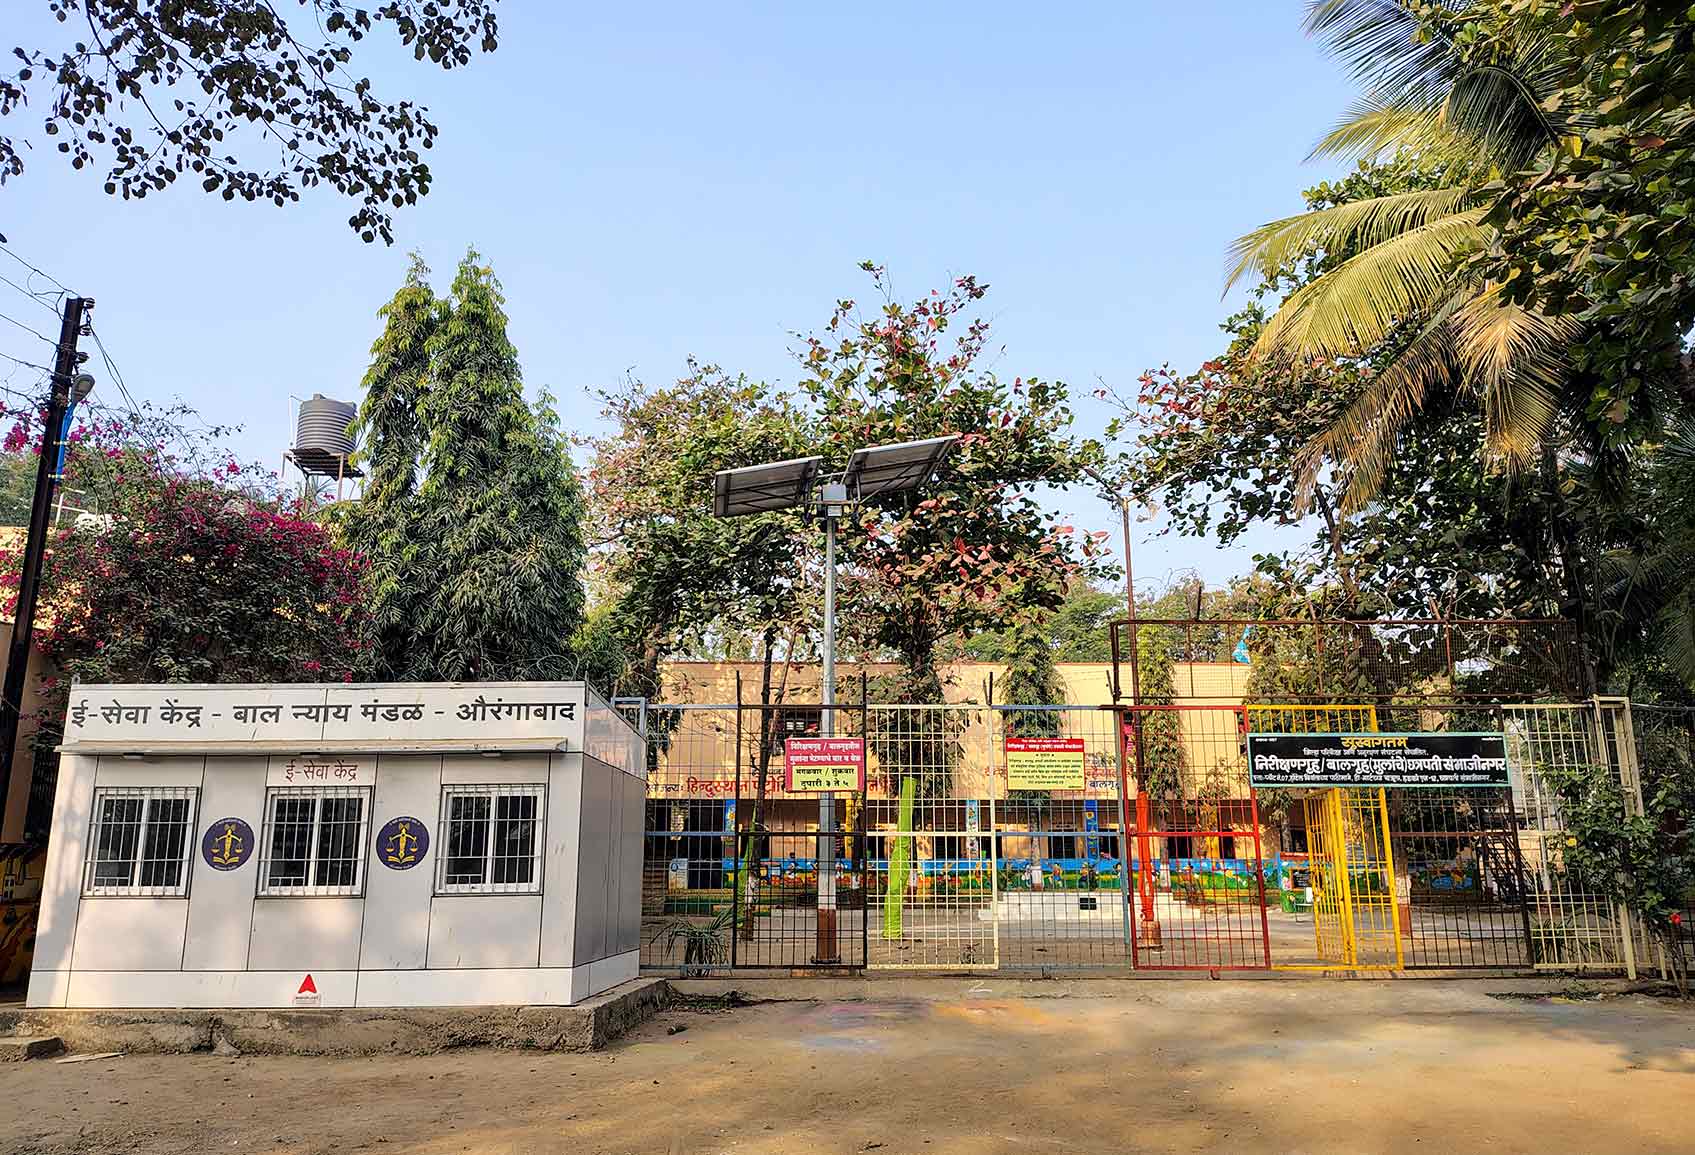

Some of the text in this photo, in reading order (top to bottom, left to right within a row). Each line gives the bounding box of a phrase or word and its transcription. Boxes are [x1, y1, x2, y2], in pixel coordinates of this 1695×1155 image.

[70, 699, 150, 727] ई-सेवा
[160, 698, 202, 728] केंद्र
[234, 703, 282, 725] बाल
[291, 702, 351, 725] न्याय
[360, 698, 425, 724] मंडळ
[456, 696, 577, 722] औरंगाबाद
[284, 761, 359, 784] ई-सेवा केंद्र
